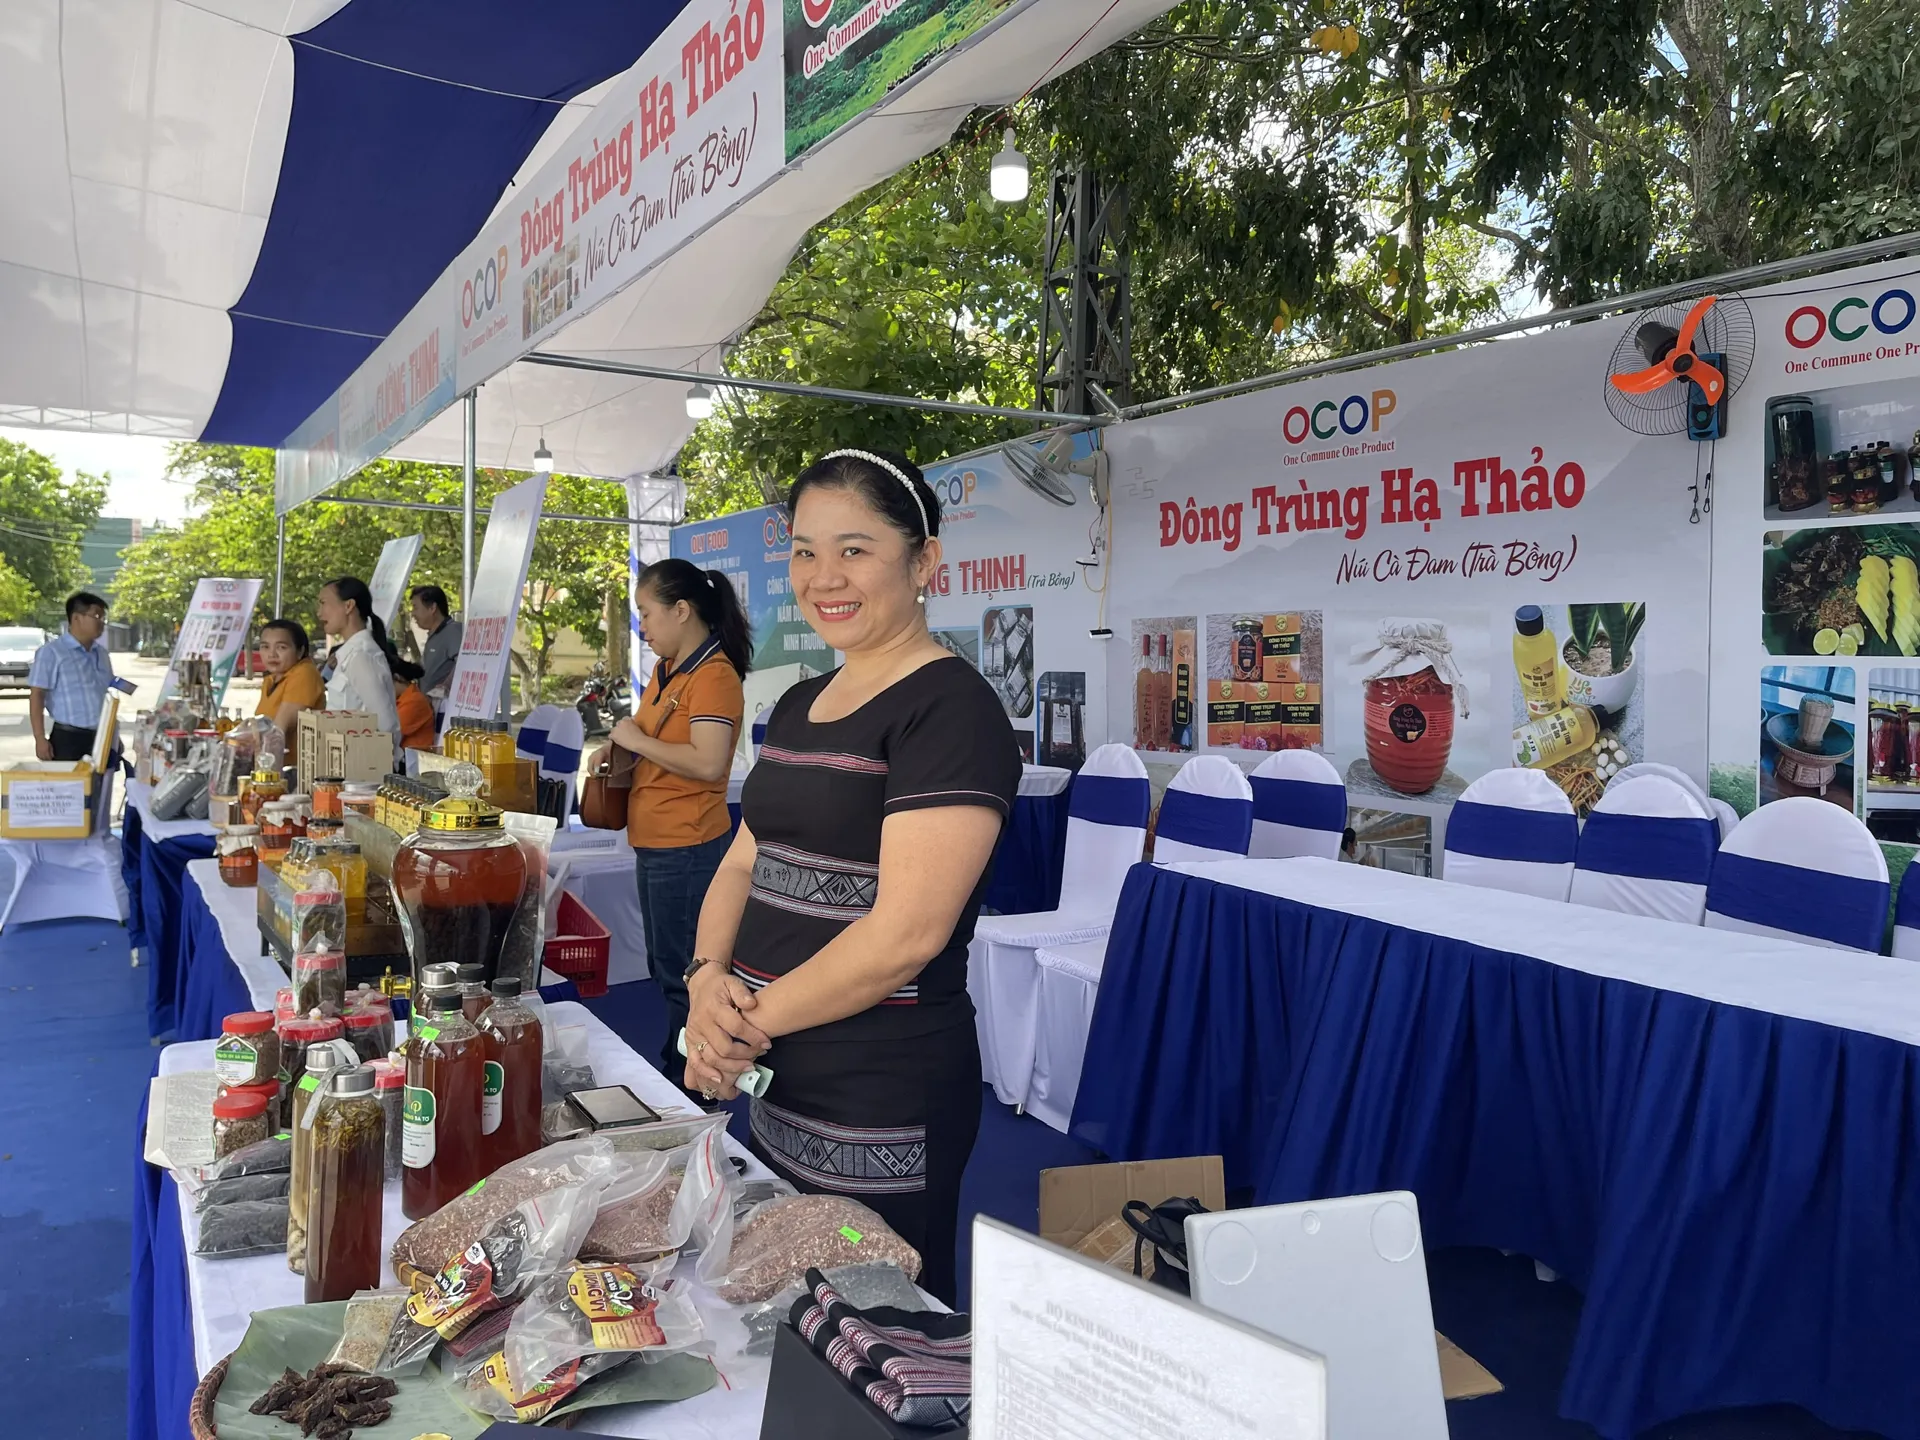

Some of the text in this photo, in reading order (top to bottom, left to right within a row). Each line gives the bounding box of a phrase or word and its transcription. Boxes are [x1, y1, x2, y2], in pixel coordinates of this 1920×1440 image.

[804, 47, 825, 75] One
[520, 0, 765, 269] Đông Trùng Hạ Thảo
[583, 226, 606, 289] Núi
[607, 213, 628, 268] Cà
[629, 192, 667, 253] Đam
[698, 91, 758, 198] Bồng)
[462, 244, 508, 329] OCOP
[1785, 289, 1916, 349] OCO
[1785, 360, 1809, 374] One
[1811, 351, 1873, 370] Commune
[1875, 346, 1901, 360] One
[1283, 389, 1397, 445] OCOP
[1283, 440, 1395, 467] One Commune One Product
[925, 471, 977, 508] COP
[1159, 446, 1586, 552] Đông Trùng Hạ Thảo
[691, 528, 729, 555] OLY FOOD
[1335, 534, 1578, 586] Núi Cà Đam (Trà Bồng)
[958, 554, 1026, 600] THỊNH
[1027, 574, 1046, 589] (Trà
[1048, 571, 1076, 590] Bồng)
